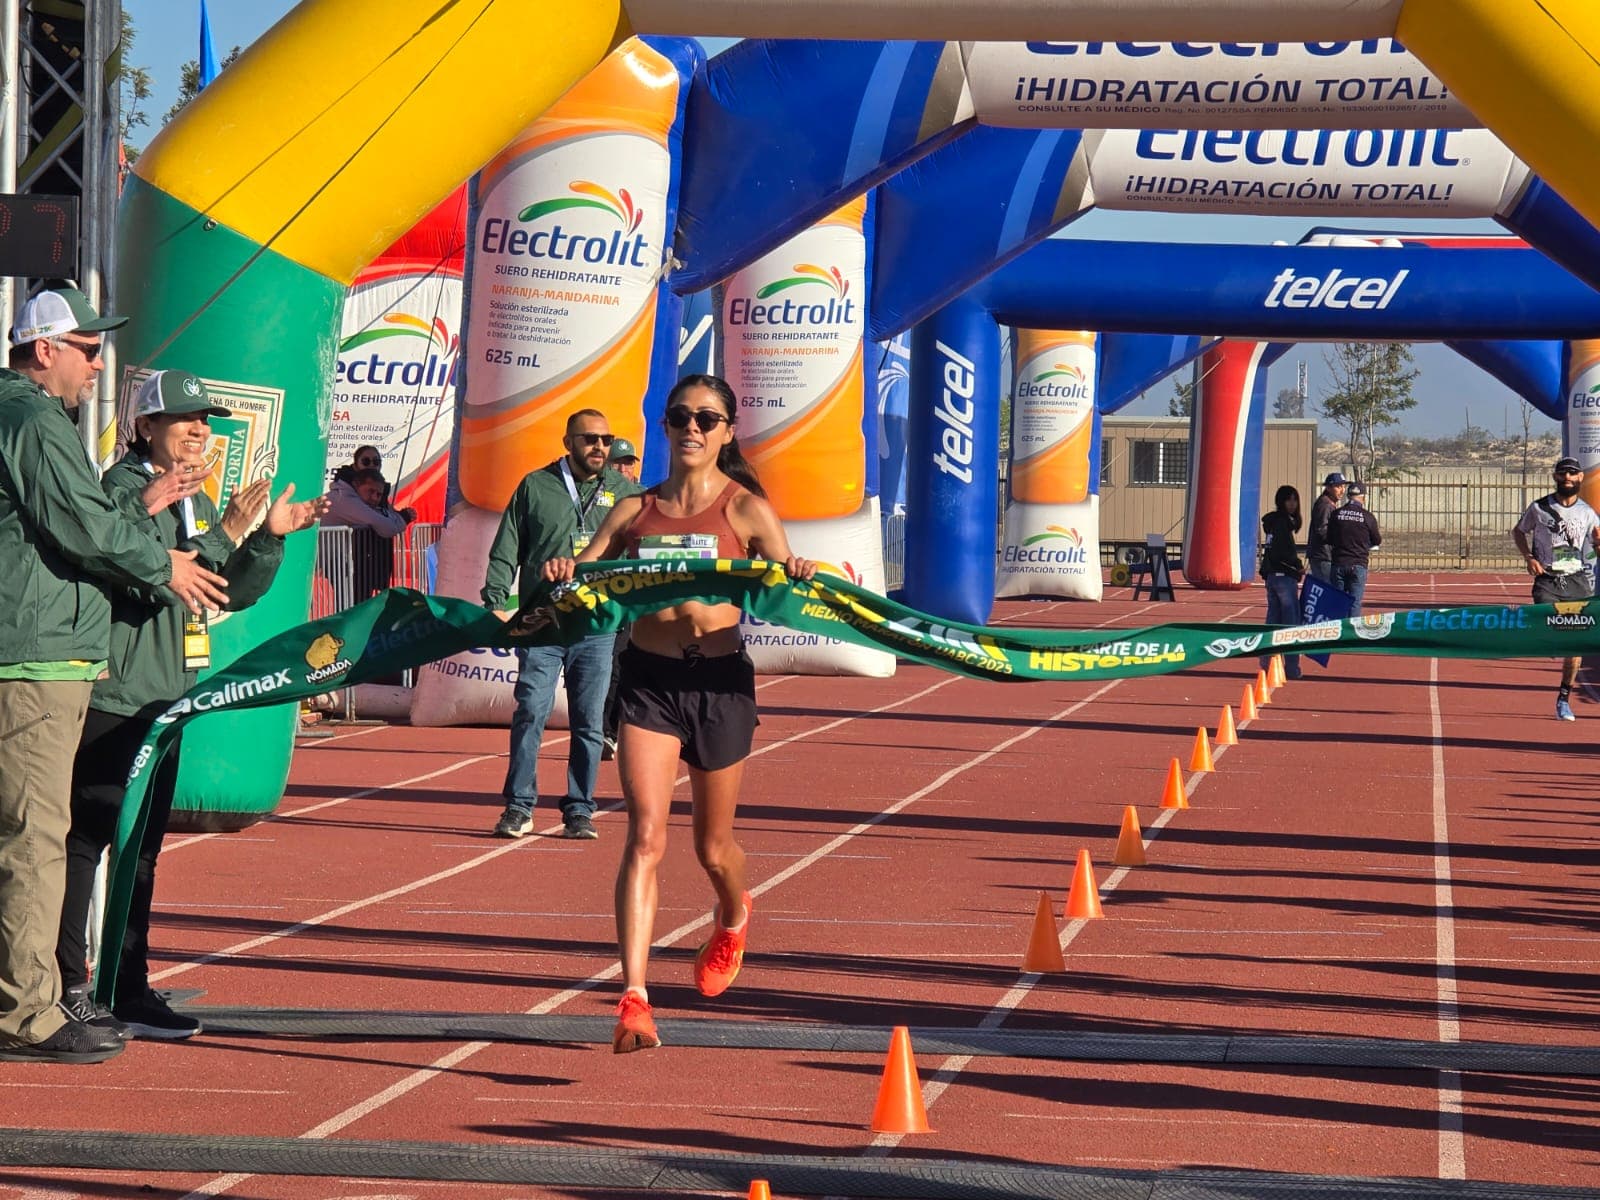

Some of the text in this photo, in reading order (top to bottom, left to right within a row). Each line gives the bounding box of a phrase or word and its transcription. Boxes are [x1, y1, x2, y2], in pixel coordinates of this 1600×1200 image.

[1315, 76, 1449, 102] TOTAL!
[1018, 105, 1081, 113] CONSULTE
[1351, 183, 1454, 201] TOTAL!
[482, 217, 649, 268] Electrolit
[494, 264, 622, 286] SUERO REHIDRATANTE
[491, 284, 620, 306] NARANJA-MANDARINA
[1263, 267, 1410, 310] telcel
[489, 299, 569, 317] Solución esterilizada
[729, 298, 855, 326] Electrolit
[497, 311, 533, 322] electrolitos
[534, 316, 557, 325] orales
[513, 324, 529, 332] para
[530, 326, 561, 335] prevenir
[742, 332, 840, 341] SUERO REHIDRATANTE
[485, 348, 541, 368] 625 mL
[741, 347, 840, 357] NARANJA-MANDARINA
[336, 353, 458, 387] ectroli
[1018, 382, 1089, 399] Electrolit
[224, 398, 238, 409] DEL
[239, 400, 268, 413] HOMBRE
[352, 394, 442, 406] REHIDRATANTE
[741, 396, 786, 408] 625 mL
[933, 339, 976, 484] telcel
[346, 423, 394, 433] esterilizada
[1339, 510, 1364, 518] OFICIAL
[1004, 545, 1087, 563] Electrolit
[1303, 583, 1325, 623] Ener
[1405, 608, 1529, 633] Electrolit
[743, 632, 818, 646] RATACIÓN
[1275, 627, 1340, 643] DEPORTES
[1134, 642, 1160, 657] DE
[976, 657, 1014, 675] 2025
[192, 667, 293, 712] Calimax
